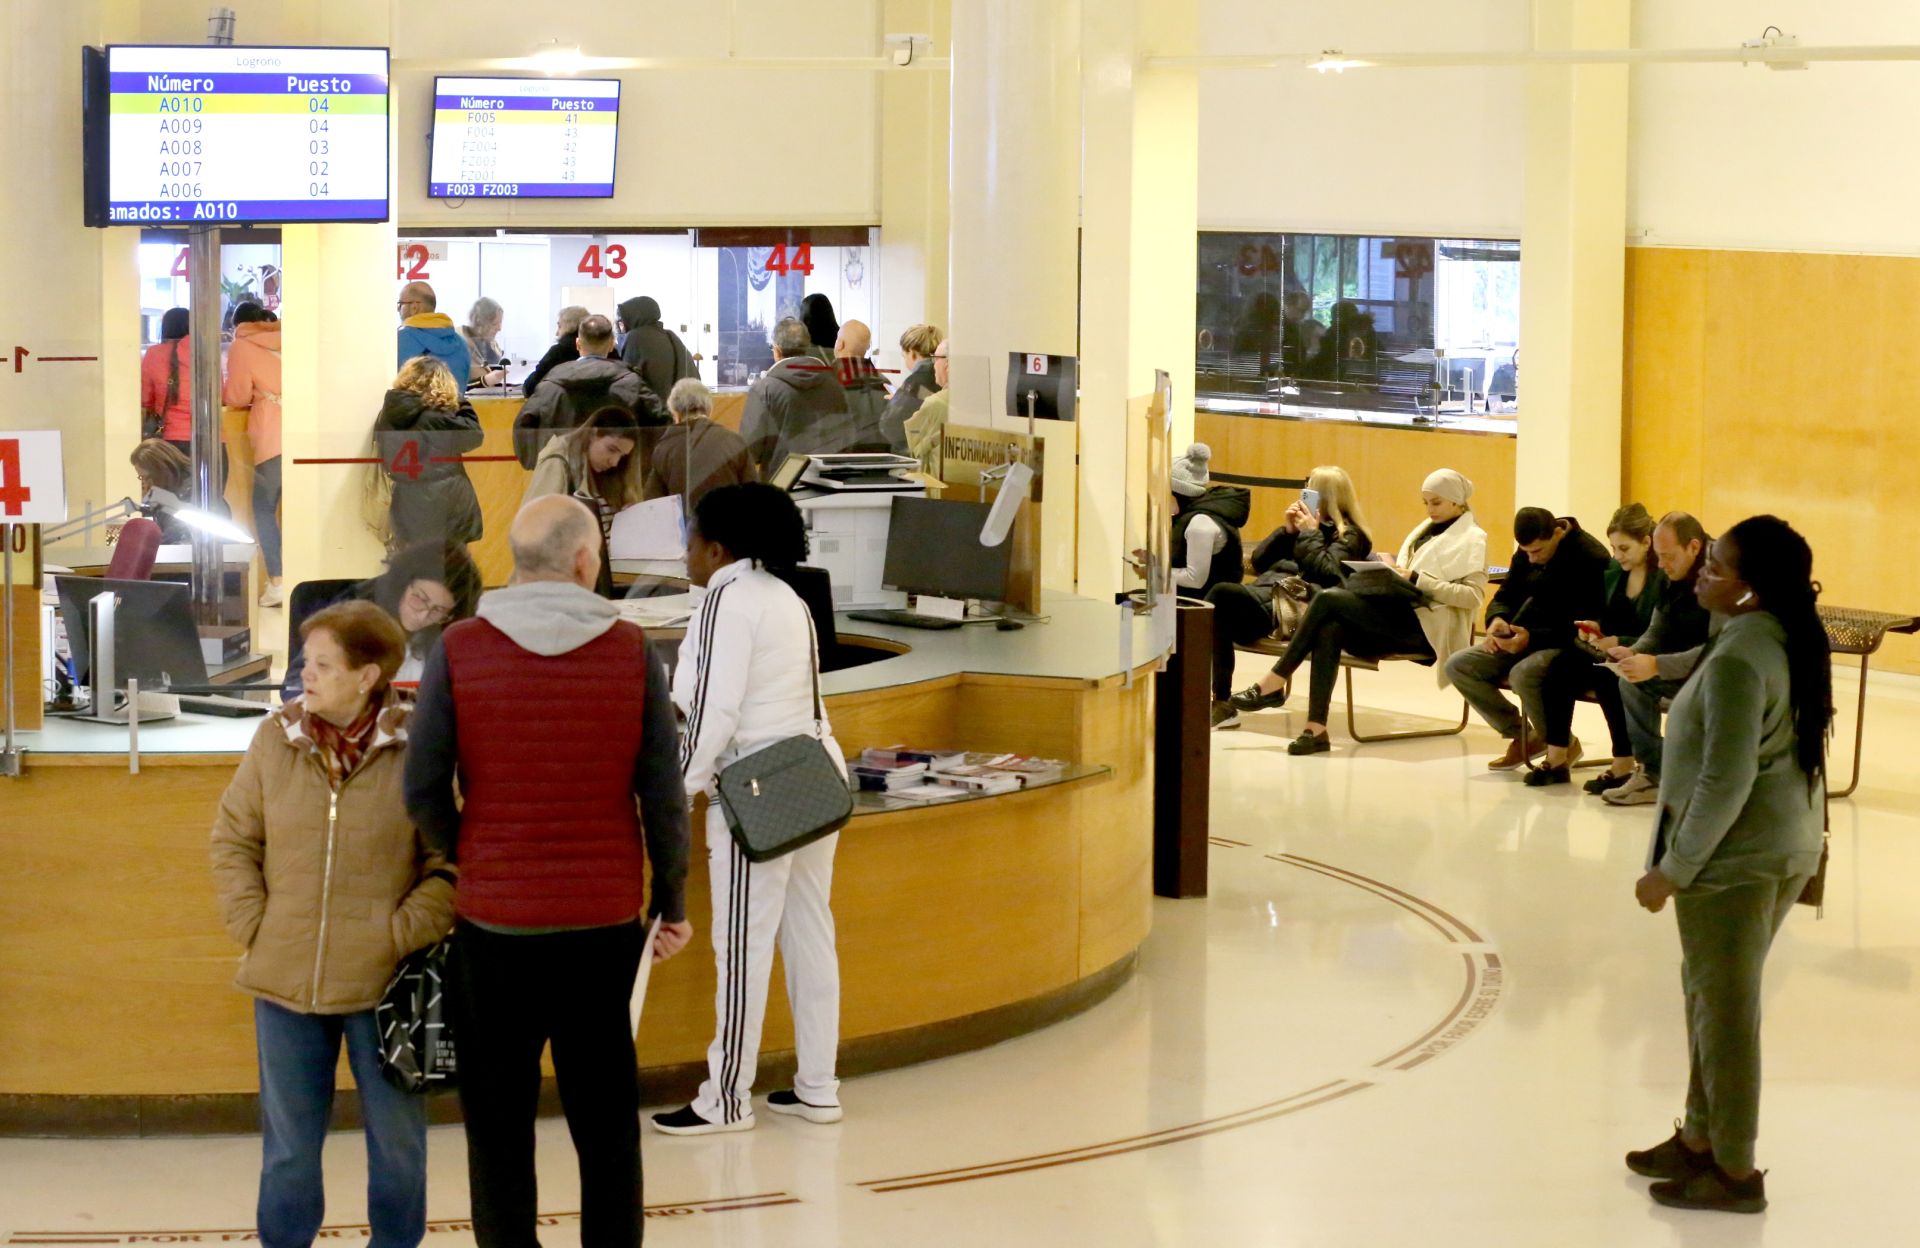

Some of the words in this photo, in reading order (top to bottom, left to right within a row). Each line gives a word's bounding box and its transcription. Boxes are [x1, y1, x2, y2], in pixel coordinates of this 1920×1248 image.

[148, 74, 214, 92] Número
[288, 76, 351, 92] Puesto
[159, 97, 203, 112] A010
[309, 98, 329, 112] 04
[460, 97, 505, 109] Número
[551, 98, 595, 111] Puesto
[467, 112, 496, 123] F005
[564, 113, 578, 124] 41
[159, 119, 203, 134] A009
[309, 119, 329, 133] 04
[467, 127, 495, 137] F004
[564, 128, 578, 138] 43
[159, 140, 203, 155] A008
[309, 140, 329, 155] 03
[563, 143, 577, 153] 42
[159, 161, 203, 176] A007
[309, 161, 329, 176] 02
[562, 156, 577, 167] 43
[561, 171, 576, 182] 43
[159, 183, 203, 198] A006
[309, 182, 329, 197] 04
[447, 184, 475, 195] F003
[482, 184, 519, 196] FZ003
[193, 202, 238, 219] A010
[397, 244, 430, 280] 2
[577, 244, 628, 279] 43
[765, 242, 814, 277] 44
[1033, 357, 1042, 372] 6
[390, 440, 424, 480] 4
[128, 1235, 202, 1243] POR
[222, 1230, 342, 1242] FAR
